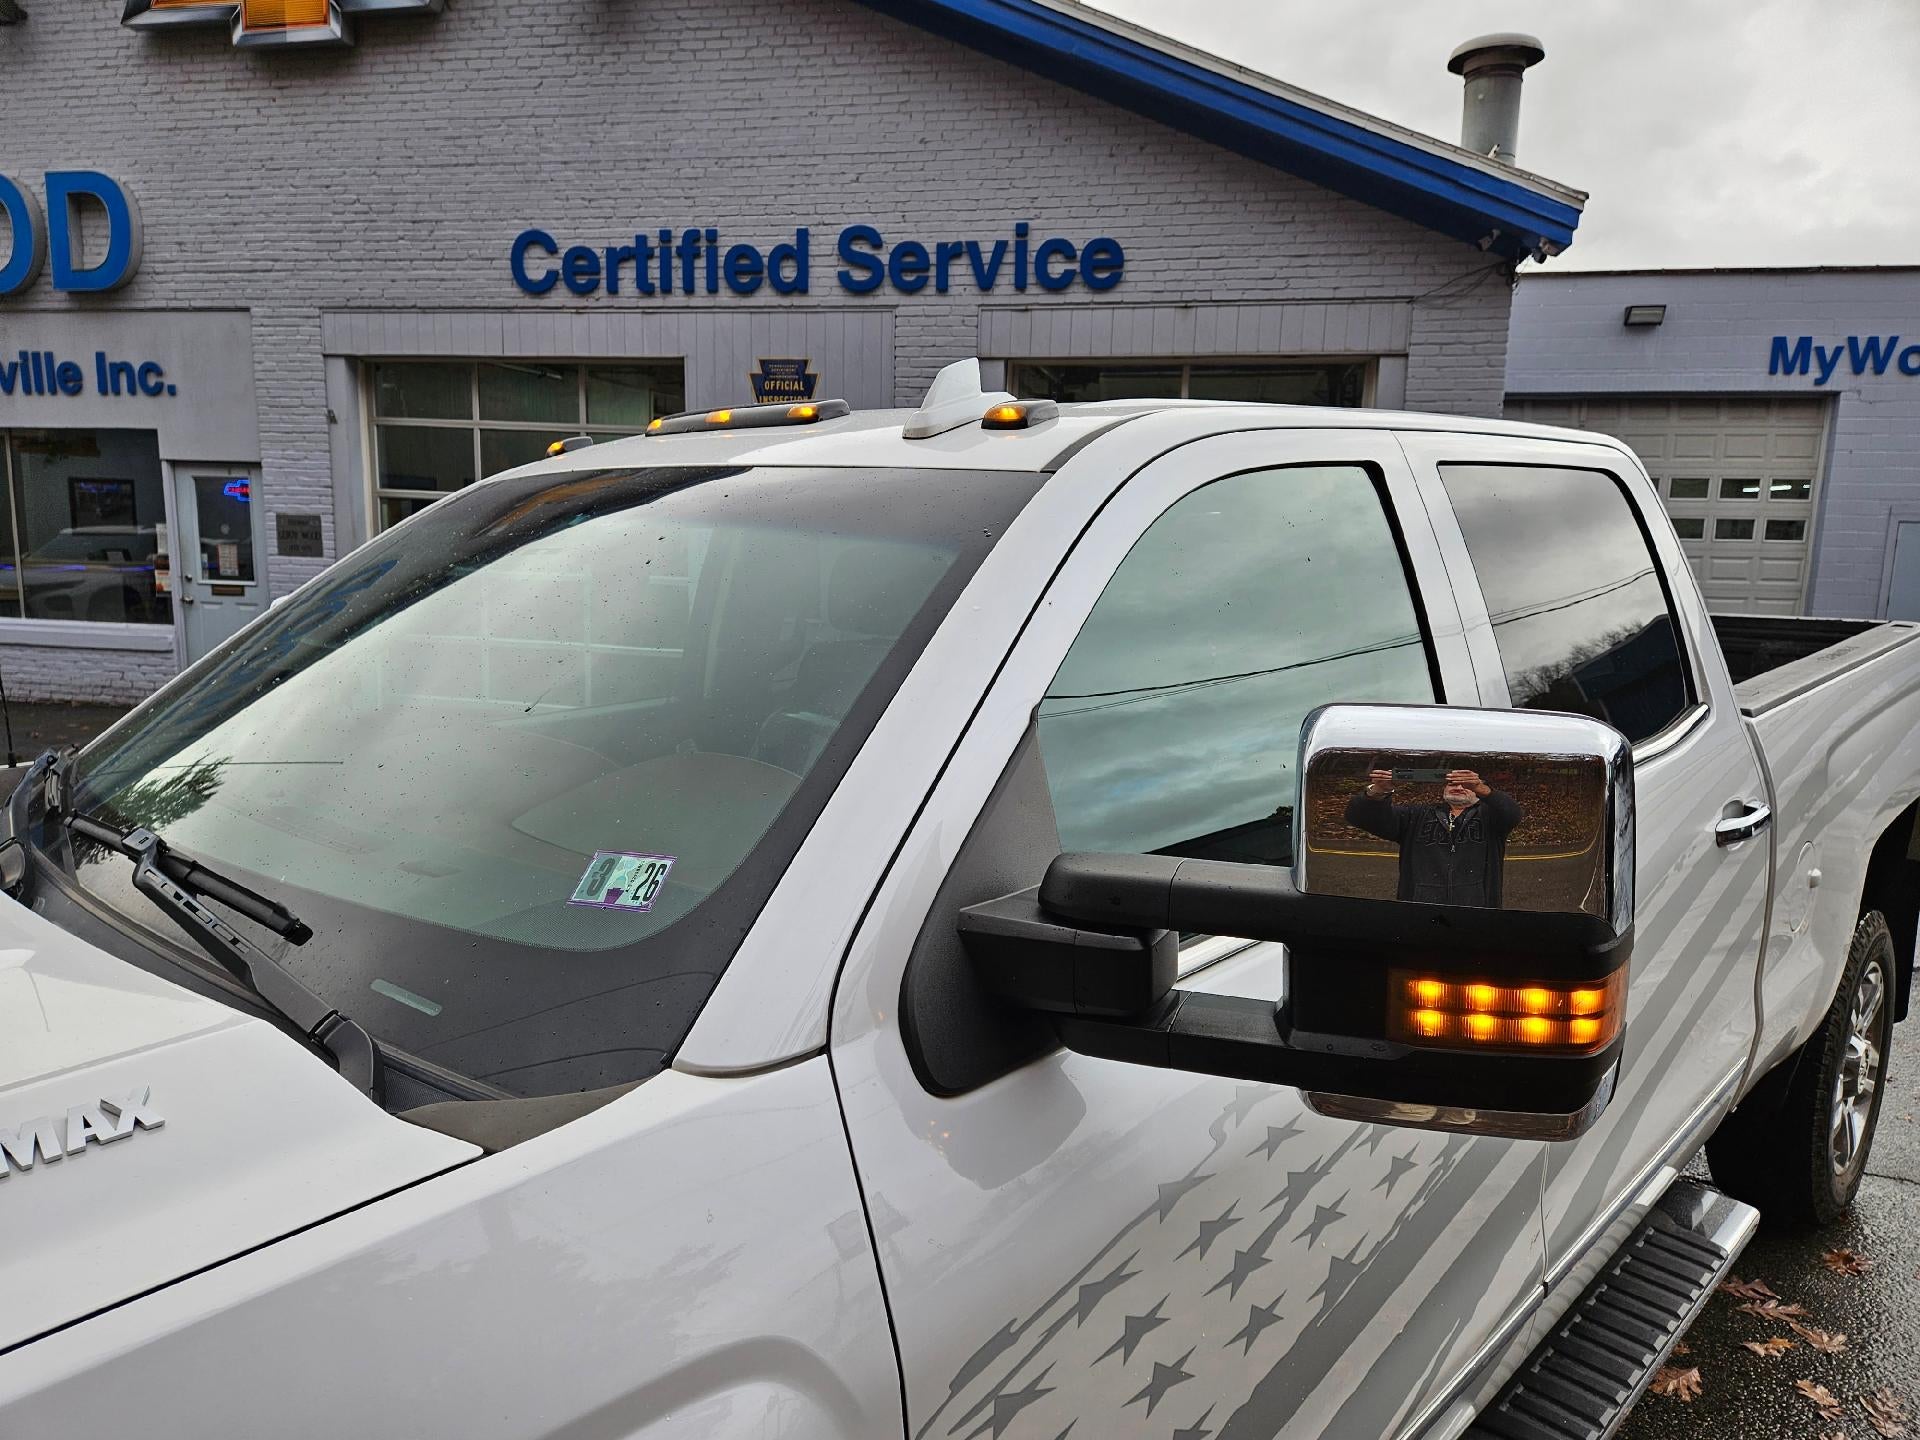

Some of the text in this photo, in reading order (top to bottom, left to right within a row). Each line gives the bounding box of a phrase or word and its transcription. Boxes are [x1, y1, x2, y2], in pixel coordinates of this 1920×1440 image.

[511, 222, 1125, 295] Certified Service
[0, 351, 177, 396] ville Inc.
[1769, 335, 1920, 386] MyWo
[764, 380, 805, 391] OFFICIAL
[631, 862, 668, 902] 26
[0, 1080, 166, 1179] MAX
